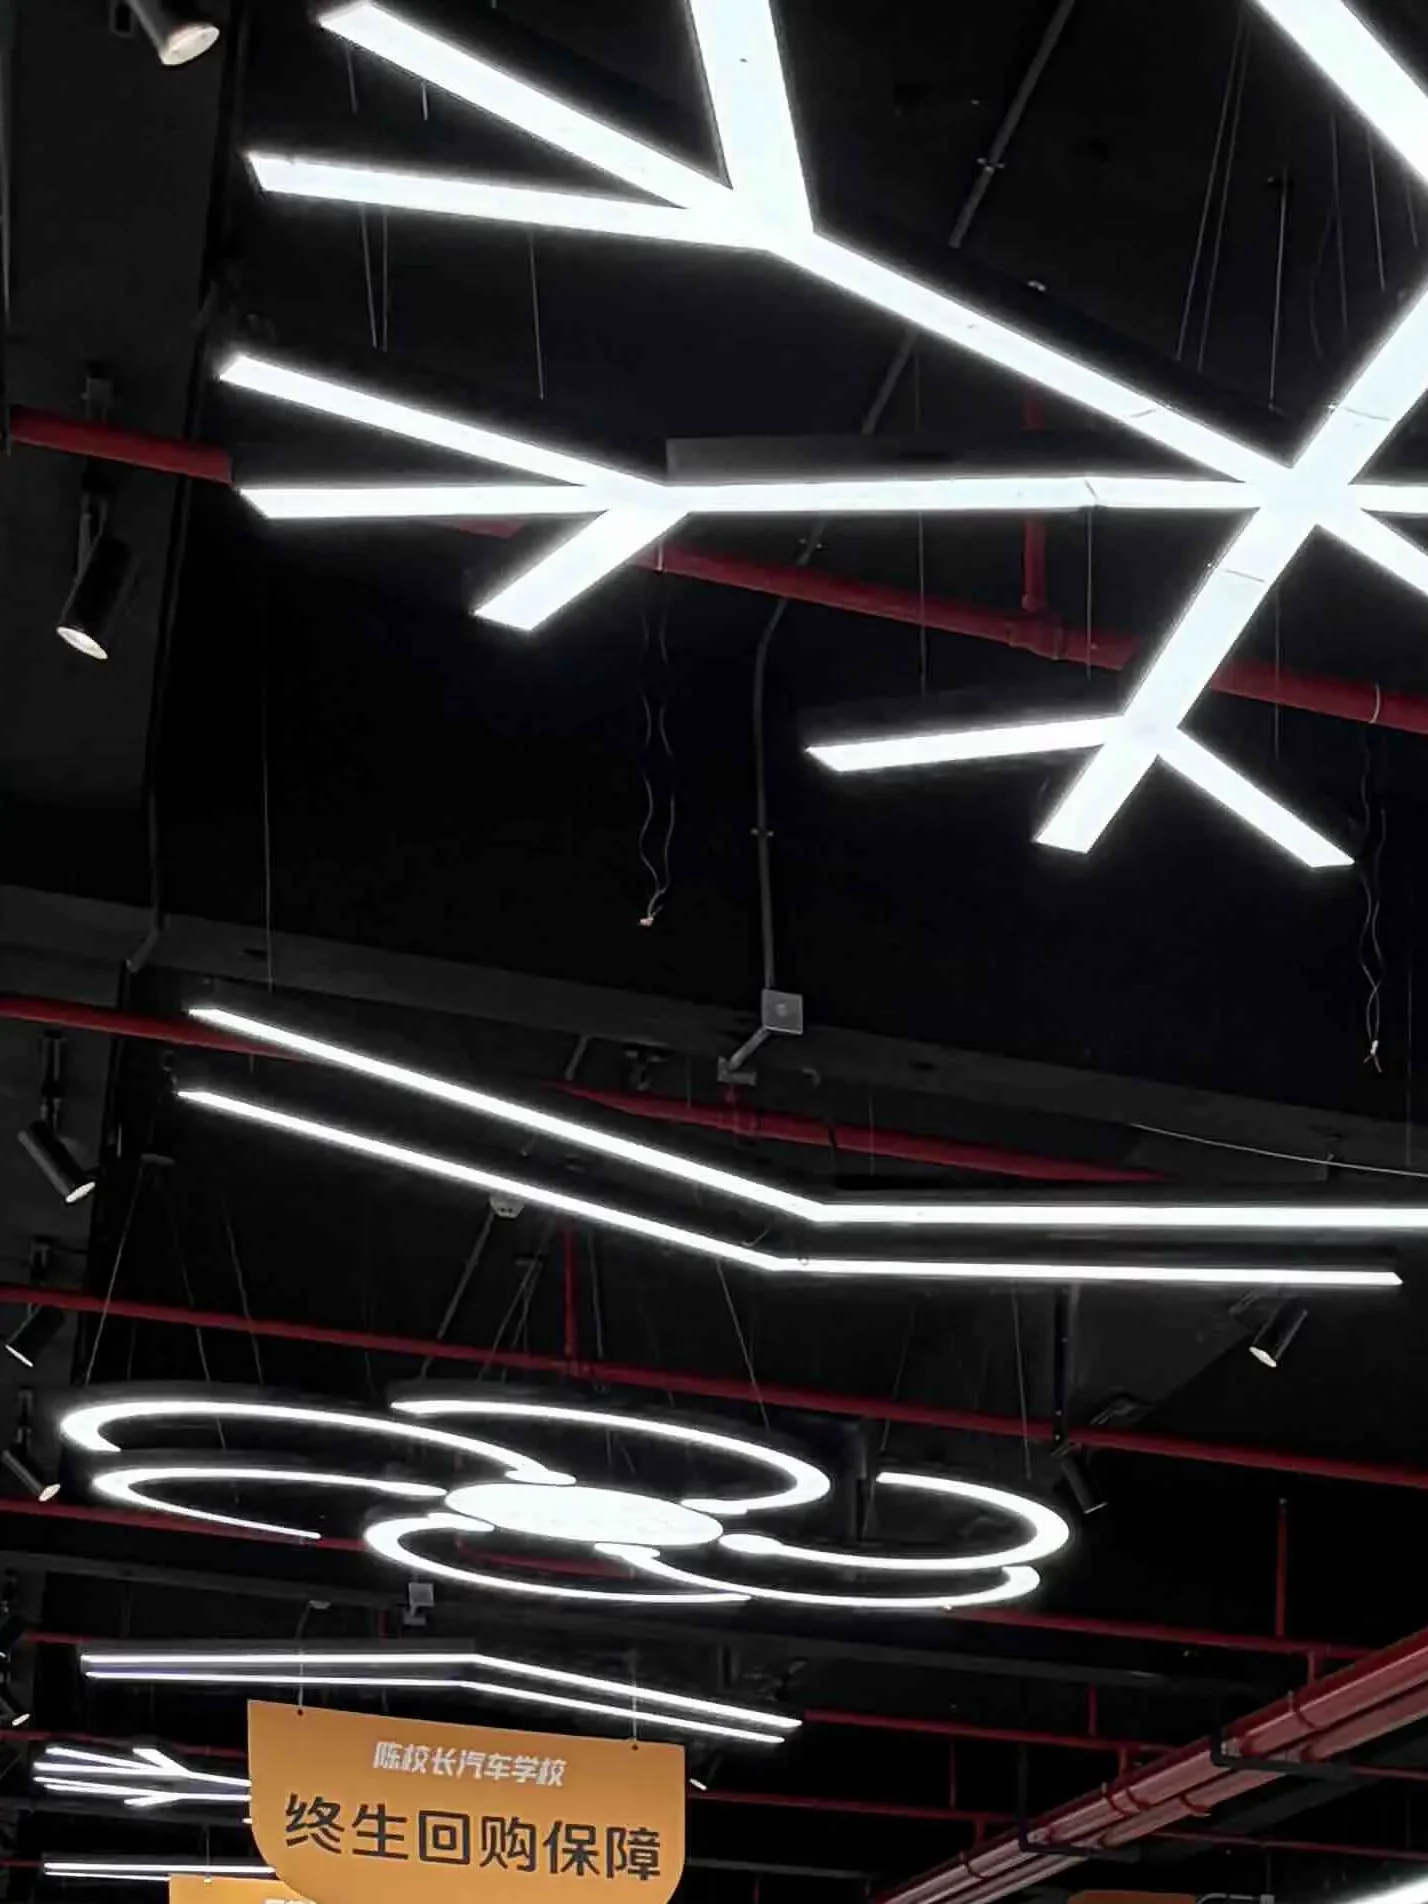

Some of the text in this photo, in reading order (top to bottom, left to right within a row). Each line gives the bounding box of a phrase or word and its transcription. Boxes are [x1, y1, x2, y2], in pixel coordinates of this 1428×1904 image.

[372, 1740, 569, 1787] 陈校长汽车学校
[286, 1792, 661, 1881] 终生回购保障
